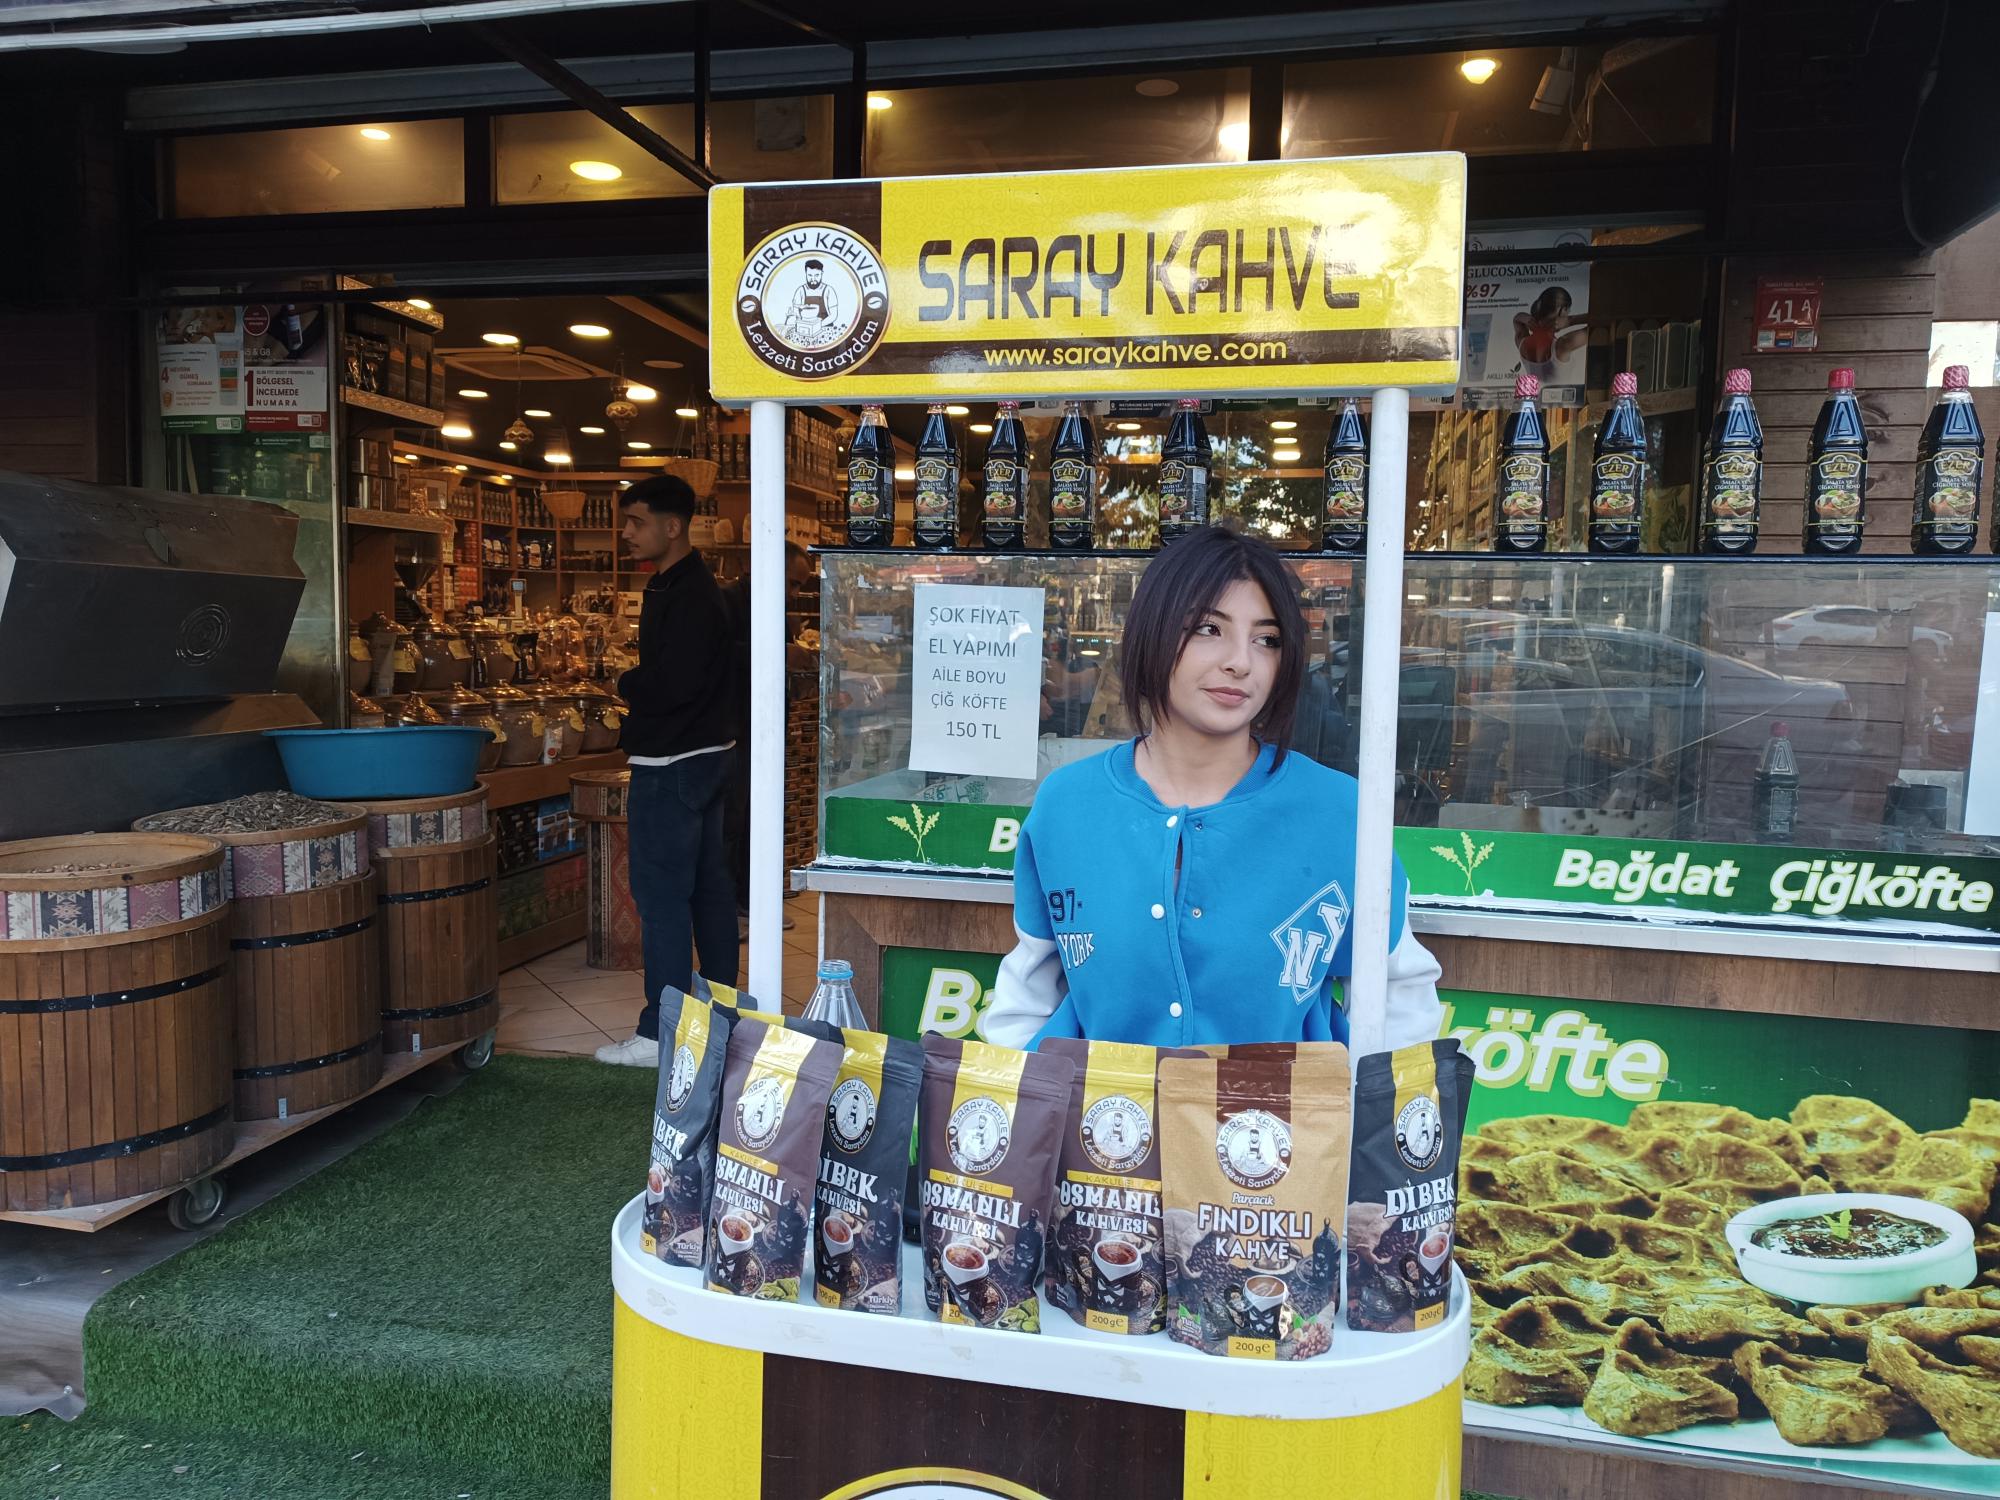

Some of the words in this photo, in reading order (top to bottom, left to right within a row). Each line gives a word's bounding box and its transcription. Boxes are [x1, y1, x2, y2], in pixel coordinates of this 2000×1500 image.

[745, 232, 807, 291] SARAY
[815, 232, 880, 287] KAHVE
[1467, 264, 1557, 279] GLUCOSAMINE
[919, 233, 1125, 322] SARAY
[1146, 227, 1360, 316] KAHVE
[1466, 283, 1501, 298] %97
[1767, 299, 1795, 323] 41
[746, 321, 798, 370] Lezzeti
[801, 320, 879, 372] Saraydan
[983, 339, 1288, 368] www.saraykahve.com
[256, 377, 294, 385] BÖLGESEL
[256, 399, 298, 407] NUMARA
[852, 467, 873, 477] EZER
[920, 467, 942, 477] EZER
[1055, 467, 1079, 477] EZER
[1510, 465, 1537, 475] EZER
[1601, 464, 1630, 473] EZER
[1825, 463, 1855, 472] EZER
[929, 606, 965, 626] ŞOK
[970, 605, 1020, 626] FİYAT
[929, 638, 947, 654] EL
[953, 639, 1016, 657] YAPIMI
[932, 668, 961, 682] AİLE
[966, 670, 1006, 684] BOYU
[931, 690, 954, 709] ÇİĞ
[962, 693, 1007, 710] KÖFTE
[946, 721, 977, 738] 150
[981, 723, 1002, 740] TL
[1553, 848, 1740, 903] Bağdat
[1768, 859, 1994, 915] Çiğköfte
[1056, 932, 1095, 970] YORK
[832, 1081, 857, 1102] SARAY
[953, 1100, 983, 1124] SARAY
[985, 1101, 1009, 1135] KAHVE
[1087, 1099, 1117, 1125] SARAY
[1120, 1100, 1149, 1131] KAHVE
[1399, 1100, 1421, 1130] SARAY
[843, 1129, 870, 1149] Saraydan
[1256, 1114, 1288, 1145] KAHVE
[967, 1150, 1003, 1172] Saraydan
[1084, 1139, 1107, 1166] Lezzeti
[1108, 1146, 1147, 1170] Saraydan
[716, 1154, 787, 1205] SMANLI
[816, 1151, 878, 1203] İBEK
[816, 1185, 863, 1216] KAHVESİ
[923, 1180, 1023, 1229] OSMANLI
[1231, 1192, 1275, 1207] Parçacık
[932, 1211, 998, 1241] KAHVESİ
[1075, 1210, 1149, 1235] KAHVESİ
[1198, 1202, 1312, 1239] FINDIKLI
[1215, 1237, 1290, 1260] KAHVE
